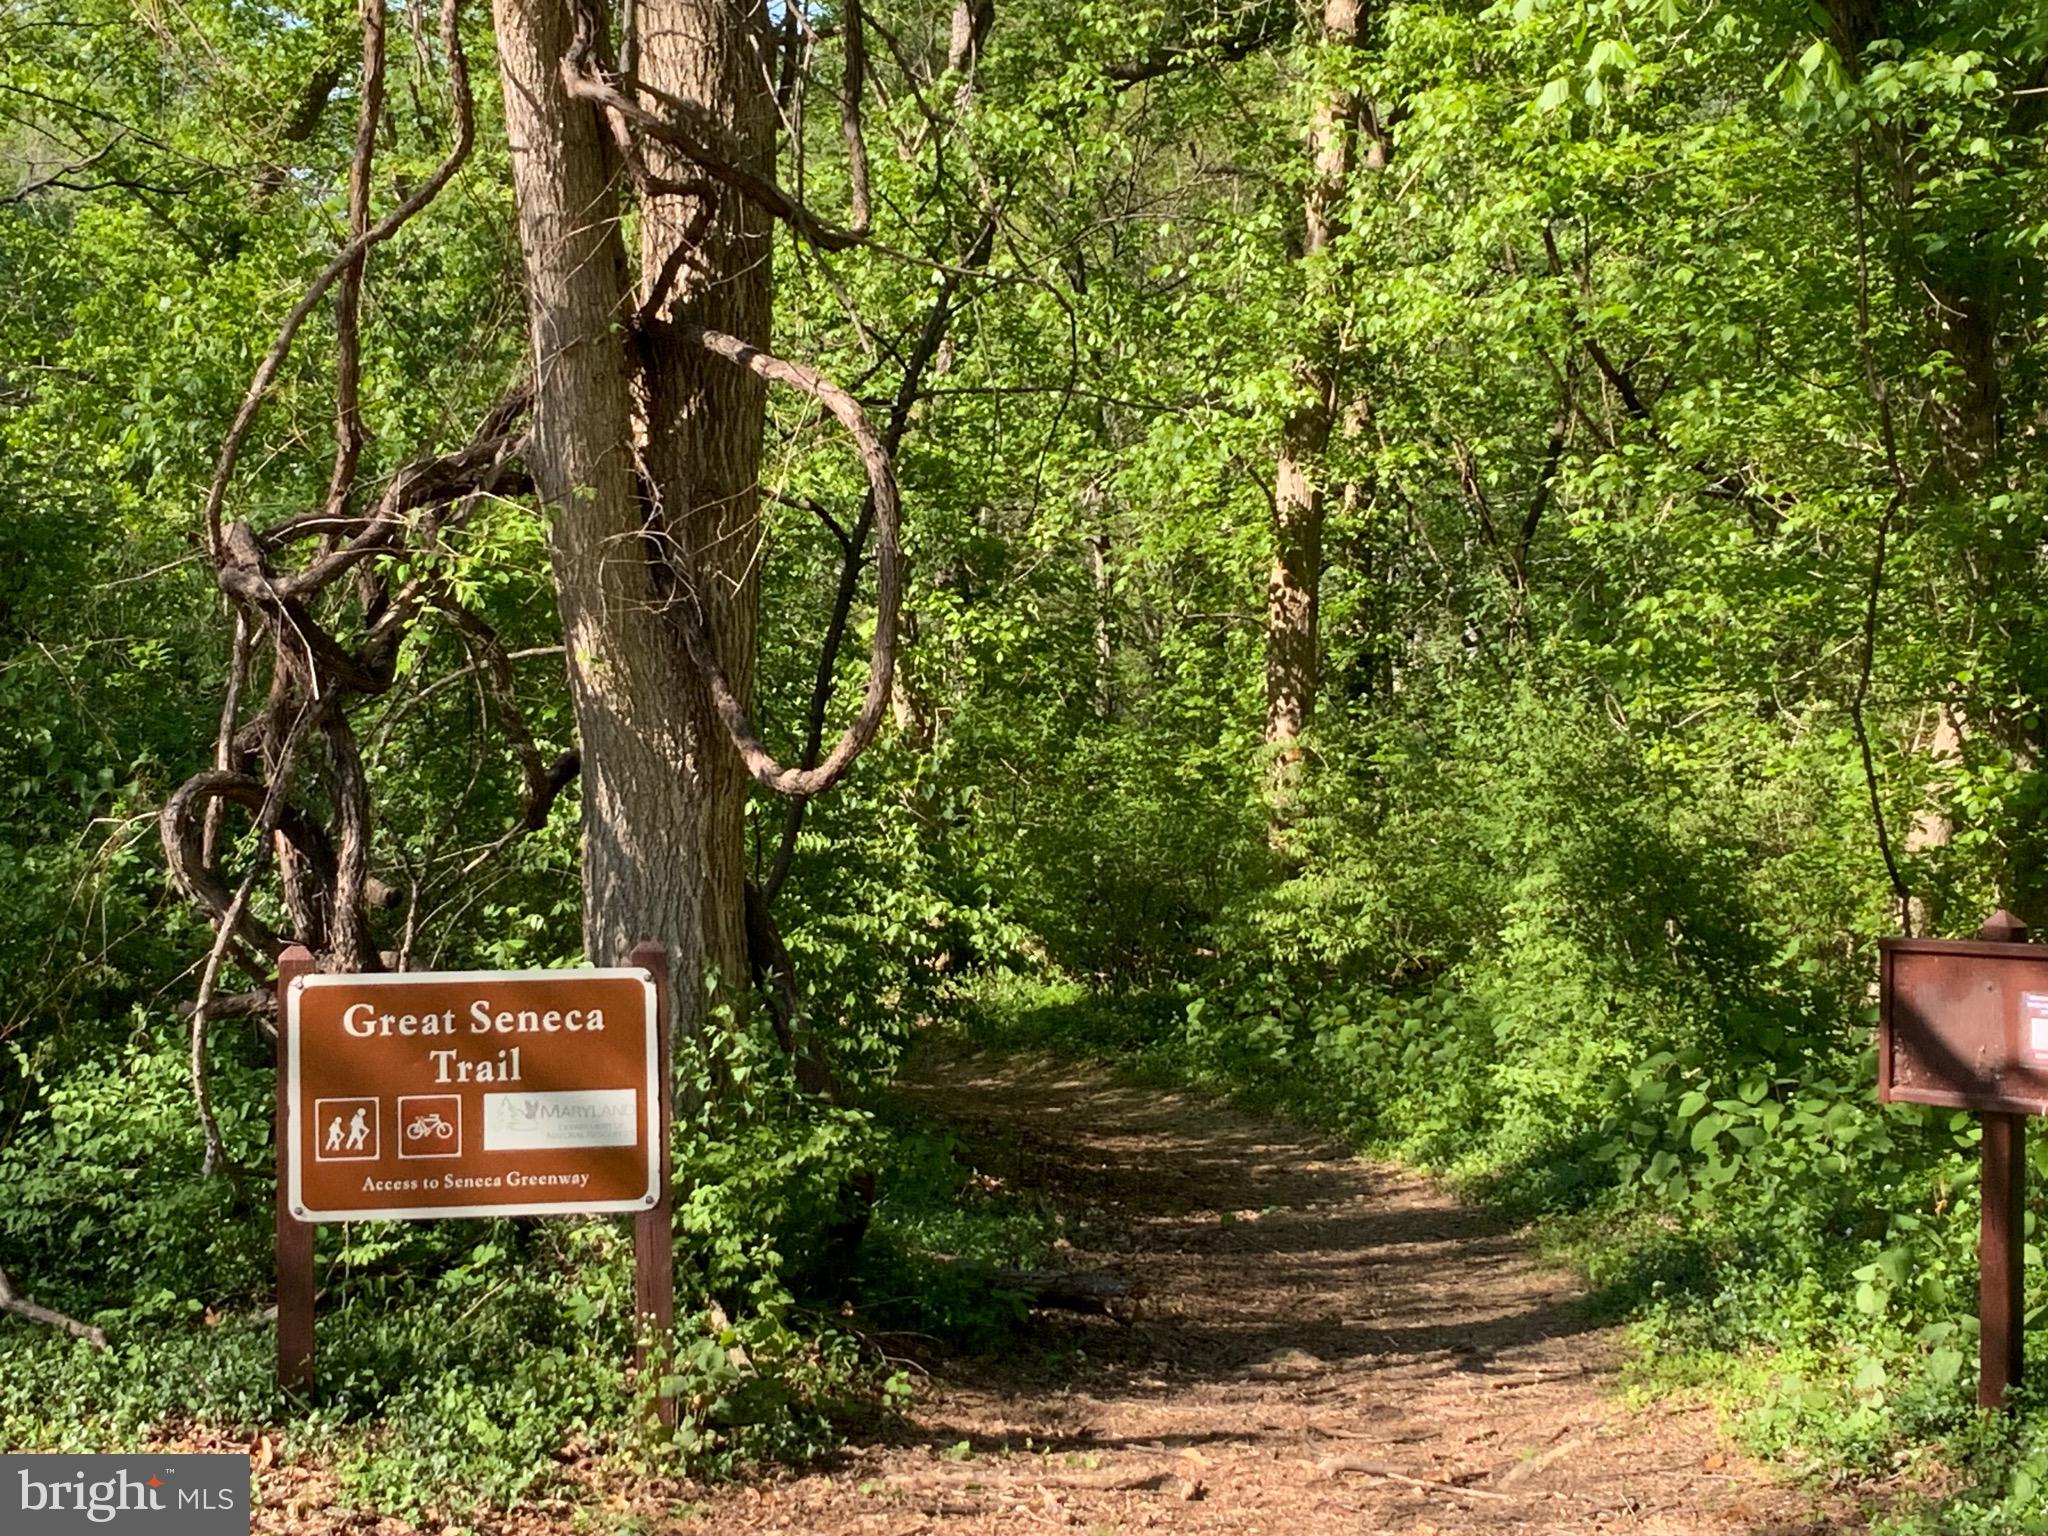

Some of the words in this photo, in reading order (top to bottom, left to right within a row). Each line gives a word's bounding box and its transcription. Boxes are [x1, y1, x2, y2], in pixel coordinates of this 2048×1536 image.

[343, 1003, 456, 1037] Great
[470, 1000, 605, 1034] Seneca
[429, 1046, 521, 1083] Trail
[362, 1176, 418, 1192] Access
[423, 1176, 439, 1190] to
[444, 1173, 501, 1189] Seneca
[506, 1172, 590, 1188] Greenway
